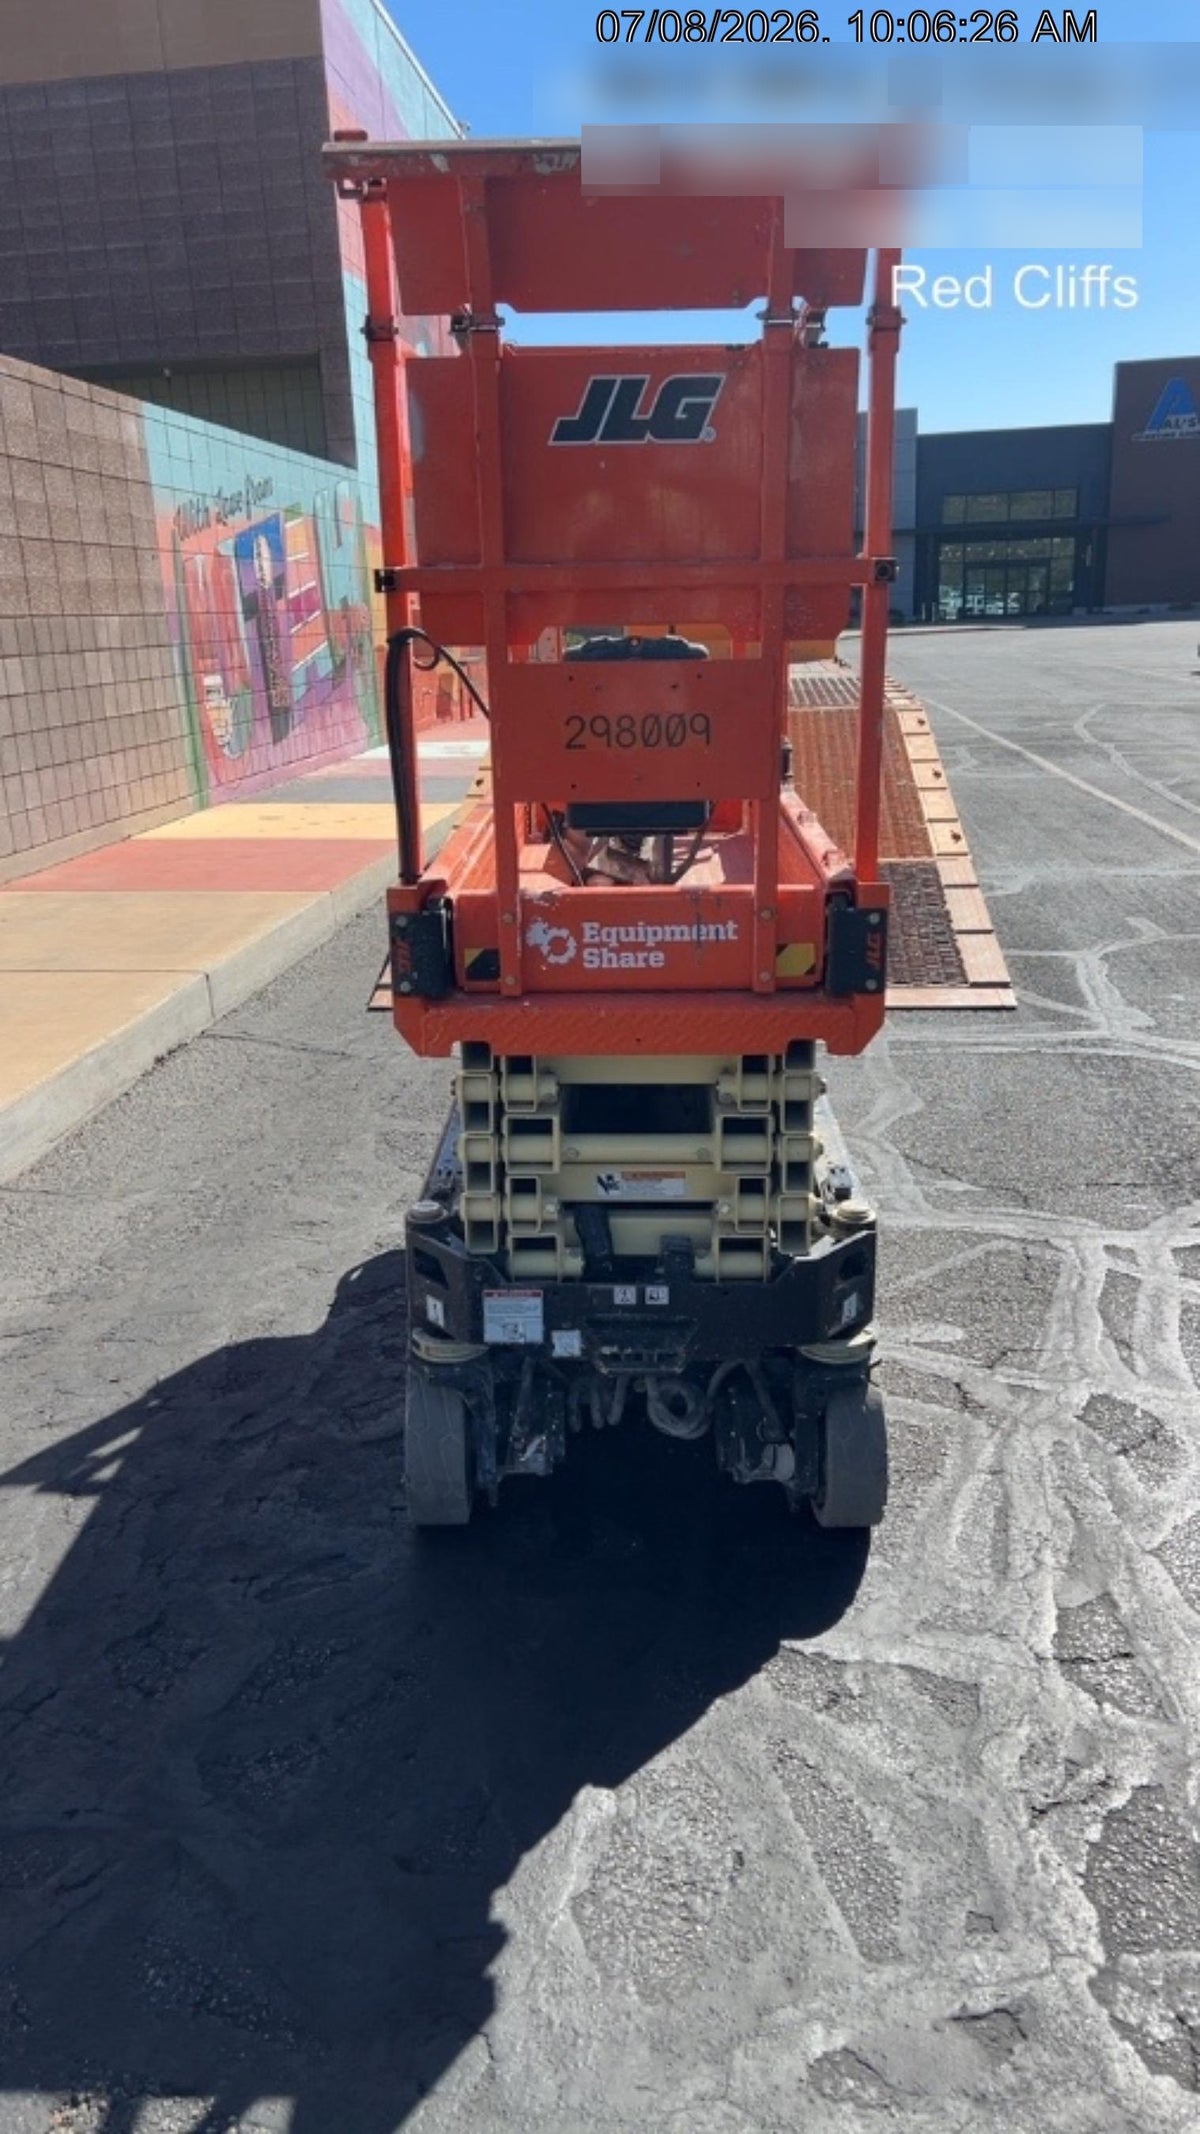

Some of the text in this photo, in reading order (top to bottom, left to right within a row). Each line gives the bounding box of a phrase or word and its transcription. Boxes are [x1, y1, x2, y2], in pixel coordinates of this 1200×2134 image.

[564, 713, 711, 750] 298009
[581, 920, 738, 947] Equipment
[581, 948, 665, 969] Share
